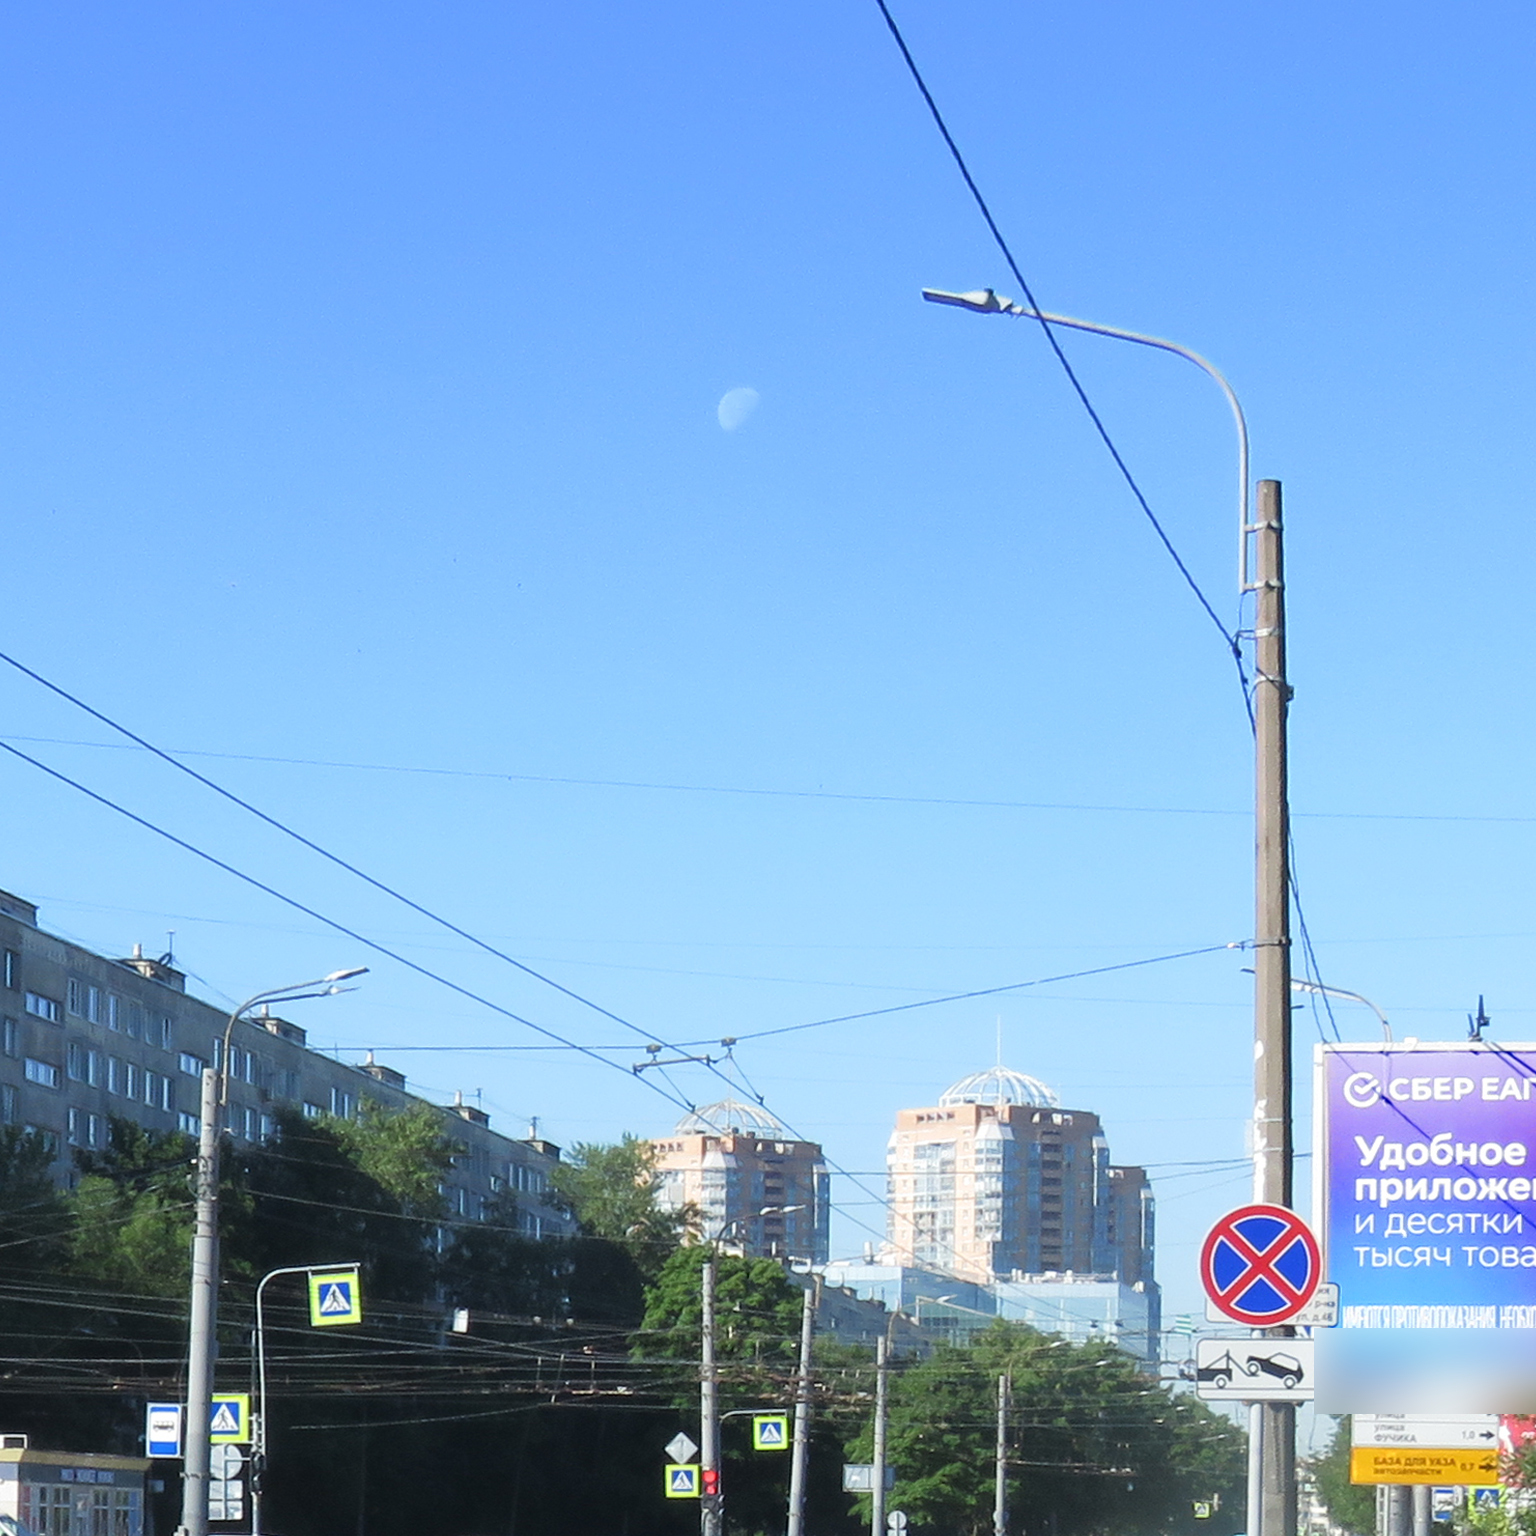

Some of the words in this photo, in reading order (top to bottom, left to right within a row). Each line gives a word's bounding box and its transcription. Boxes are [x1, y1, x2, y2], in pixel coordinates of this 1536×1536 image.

[1389, 1076, 1474, 1100] СБЕР
[1354, 1133, 1527, 1171] Удобное
[1355, 1213, 1374, 1234] и
[1384, 1213, 1523, 1238] десятки
[1354, 1246, 1451, 1268] тысяч
[1374, 1434, 1417, 1443] ФУЧИКА
[1374, 1457, 1402, 1466] БАЗА
[1404, 1457, 1427, 1466] ДЛЯ
[1429, 1458, 1457, 1467] УАЗА
